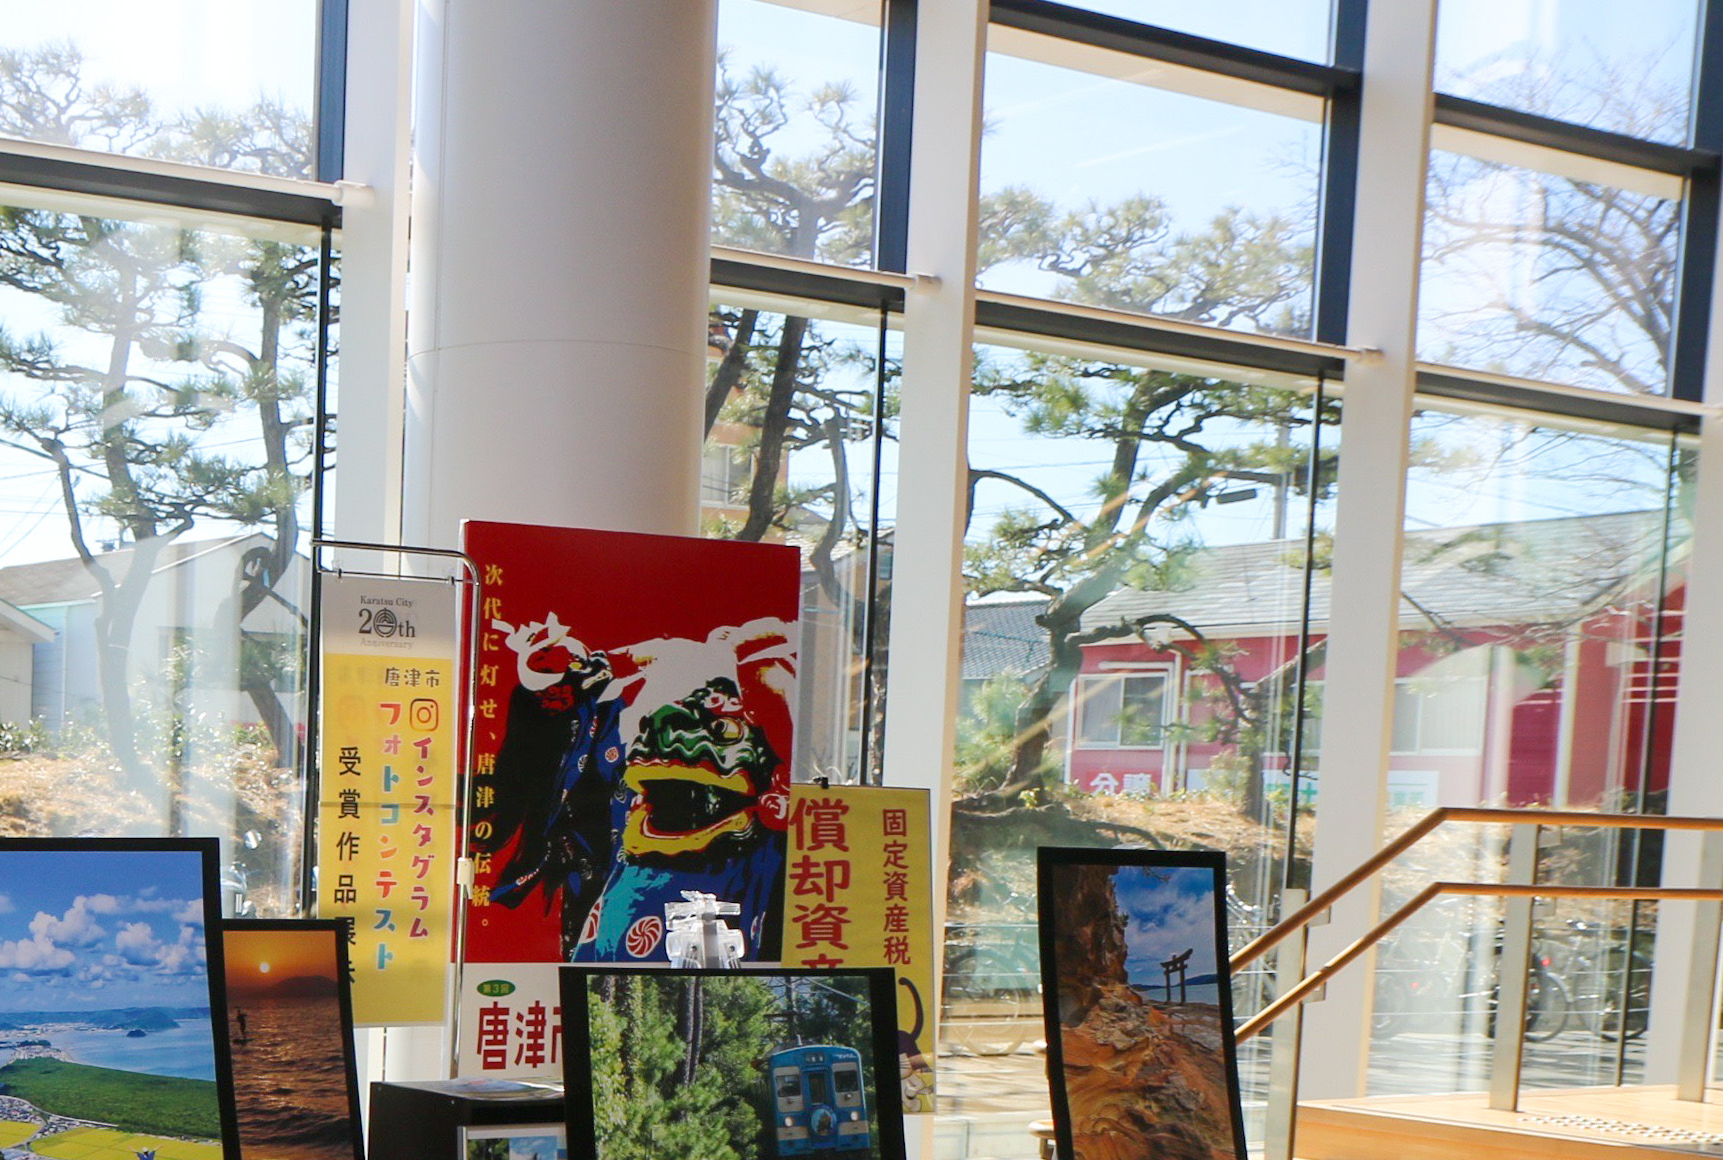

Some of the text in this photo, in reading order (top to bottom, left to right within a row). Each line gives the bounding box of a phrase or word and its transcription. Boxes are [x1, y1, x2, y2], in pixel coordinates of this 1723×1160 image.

[360, 595, 414, 608] Karatsu City
[384, 667, 440, 688] 唐津市
[373, 702, 402, 970] フォトコンテスト
[409, 736, 435, 938] インスタグラム
[882, 808, 911, 965] 固定資産税
